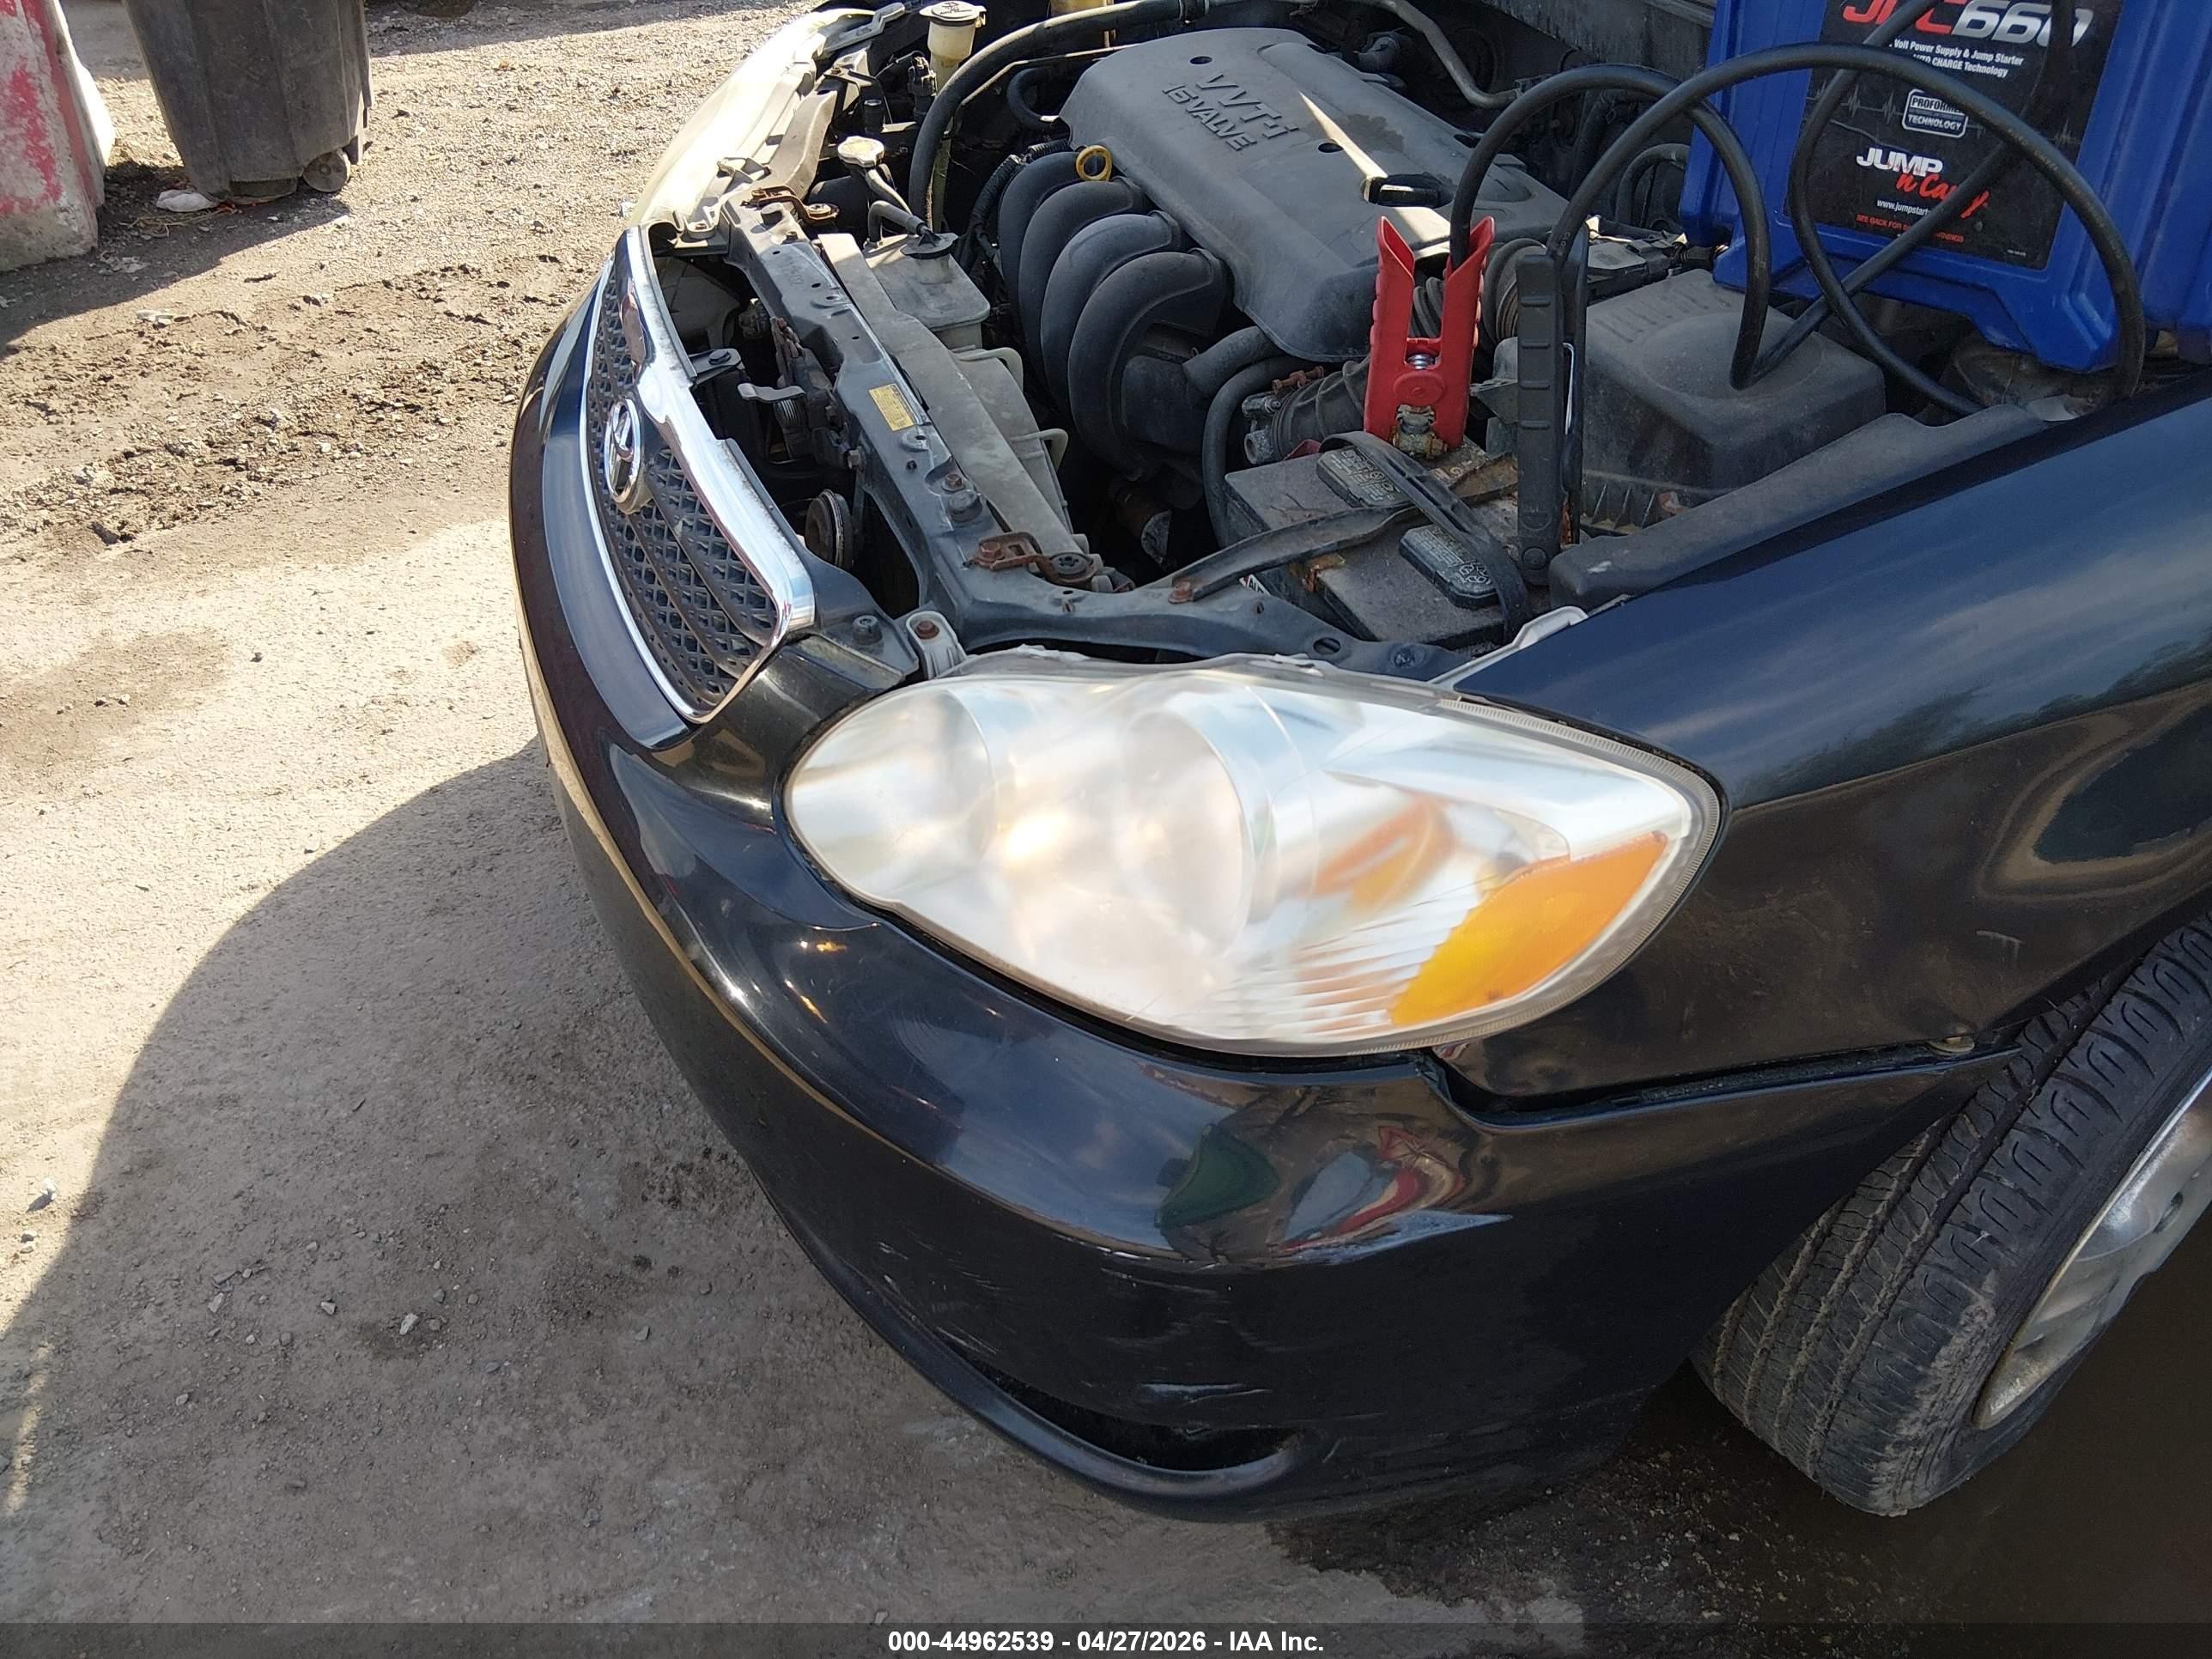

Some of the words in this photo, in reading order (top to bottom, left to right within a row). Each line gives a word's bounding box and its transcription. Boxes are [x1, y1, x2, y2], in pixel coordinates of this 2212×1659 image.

[1894, 39, 1909, 50] Volt
[1910, 41, 1935, 53] Power
[1935, 45, 1963, 58] Supply
[1963, 49, 1970, 58] &
[1971, 50, 1994, 63] Jump
[1995, 53, 2025, 65] Starter
[1932, 57, 1963, 70] CHARGE
[1964, 62, 2009, 78] Technology
[1908, 114, 1962, 131] TECHNOLOGY
[1856, 148, 1943, 177] JUMP
[1896, 173, 1917, 192] n
